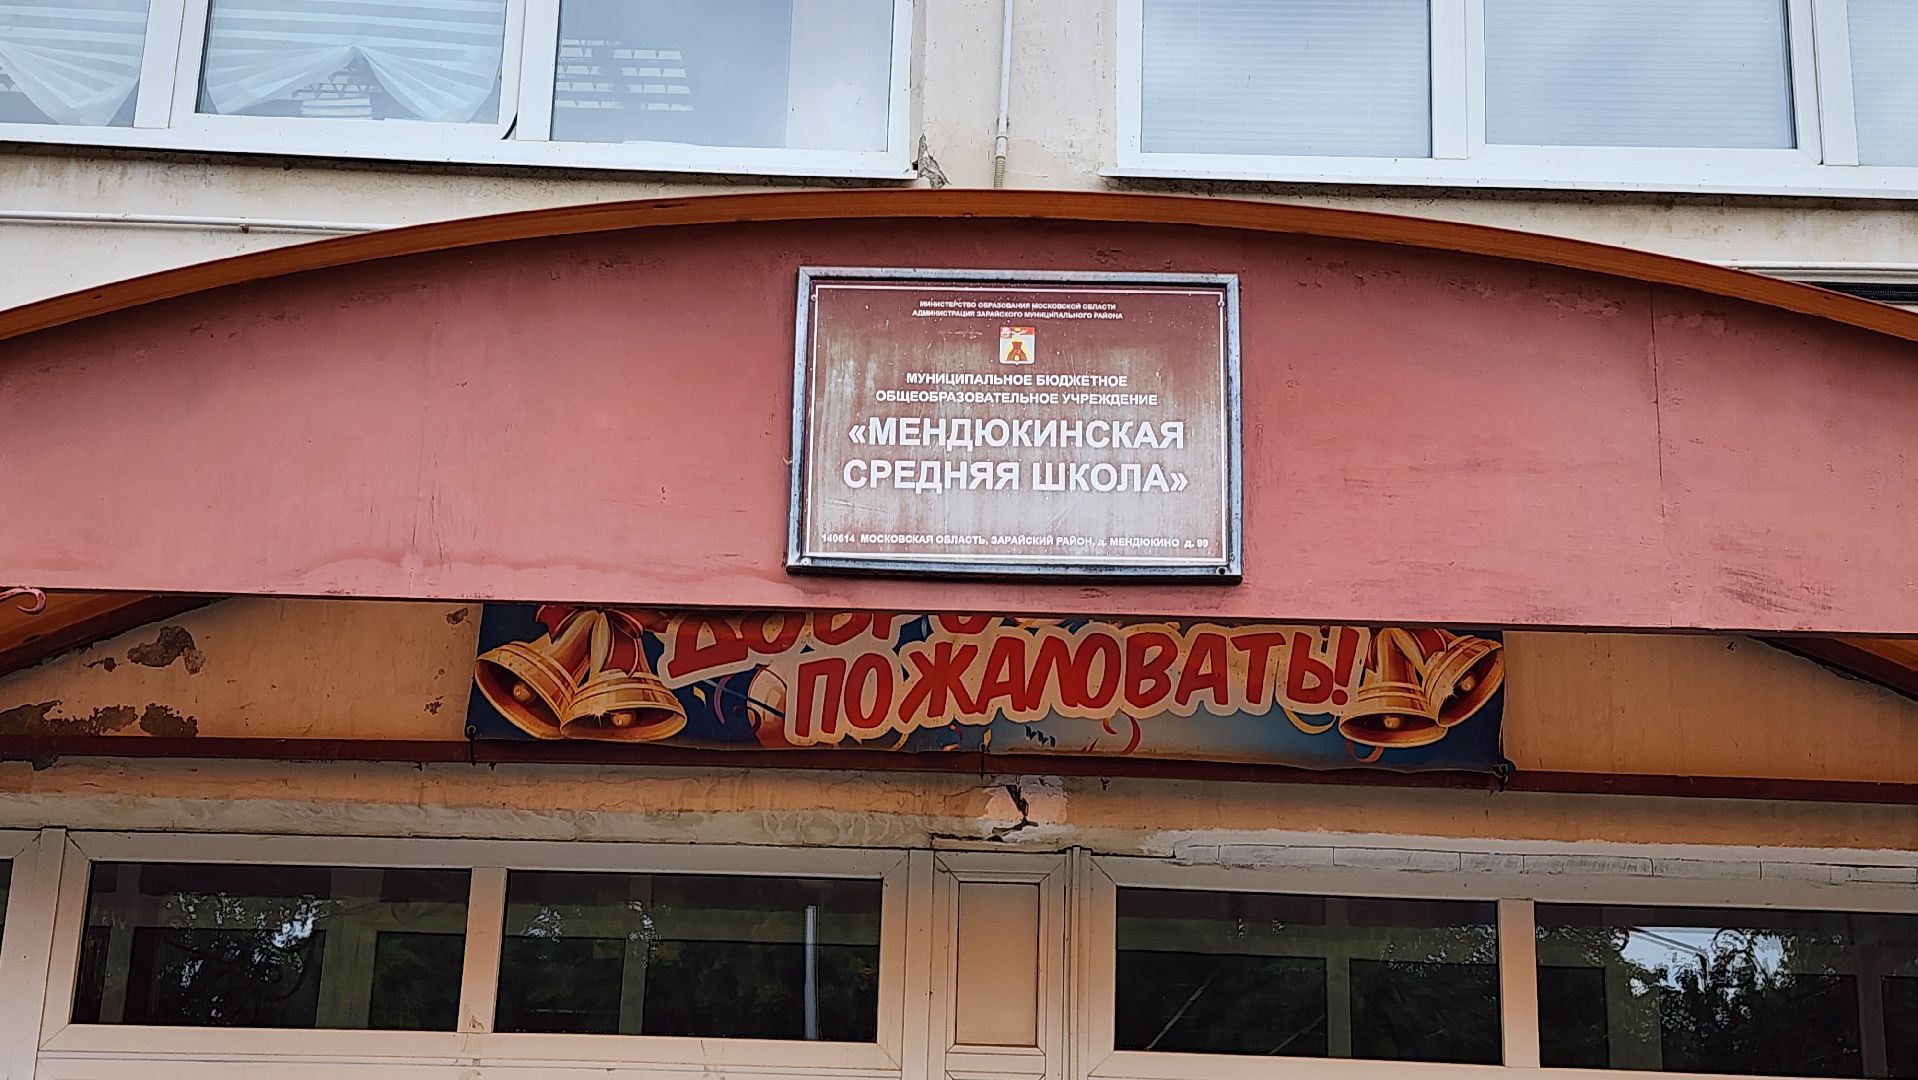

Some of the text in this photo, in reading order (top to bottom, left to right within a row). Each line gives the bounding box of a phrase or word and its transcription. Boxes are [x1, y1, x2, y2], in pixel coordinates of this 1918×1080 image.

[919, 300, 1116, 311] МИНИСТЕРСТВО ОБРАЗОВАНИЯ МОСКОВСКОЙ ОБЛАСТИ
[912, 309, 1123, 320] АДМИНИСТРАЦИЯ ЗАРАЙСКОГО МУНИЦИПАЛЬНОГО РАЙОНА
[906, 372, 1128, 389] МУНИЦИПАЛЬНОЕ БЮДЖЕТНОЕ
[876, 390, 1158, 407] ОБЩЕОБРАЗОВАТЕЛЬНОЕ УЧРЕЖДЕНИЕ
[848, 416, 1185, 452] «МЕНДЮКИНСКАЯ
[843, 459, 1189, 494] СРЕДНЯЯ ШКОЛА»
[860, 534, 933, 544] МОСКОВСКАЯ
[936, 534, 989, 545] ОБЛАСТЬ,
[991, 534, 1053, 545] ЗАРАЙСКИЙ
[1056, 535, 1096, 547] РАЙОН,
[1098, 538, 1108, 547] д.
[1109, 537, 1180, 548] МЕНДЮКИНО
[795, 626, 1359, 737] ПОЖАЛОВАТЬ!
